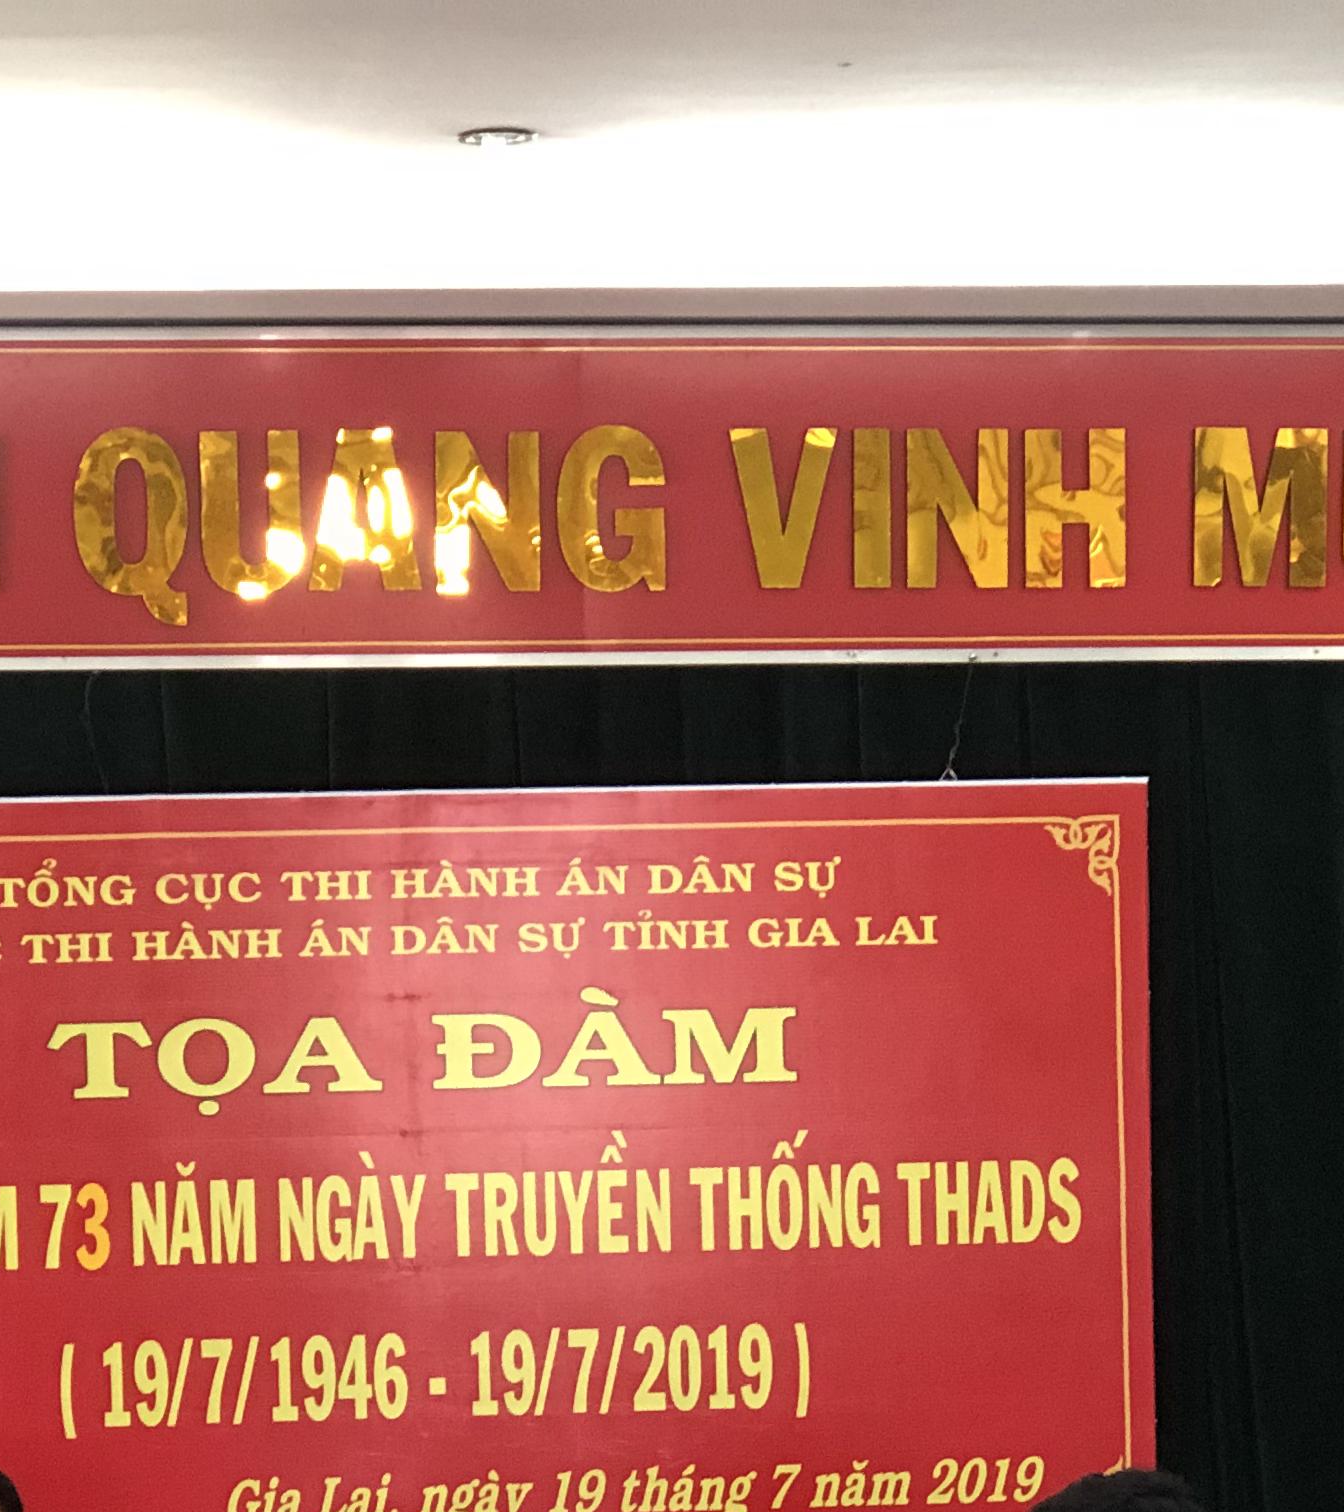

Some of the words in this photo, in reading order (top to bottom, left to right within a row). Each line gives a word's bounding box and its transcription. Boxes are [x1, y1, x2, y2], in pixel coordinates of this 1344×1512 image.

[72, 424, 666, 627] QUANG
[728, 427, 1126, 591] VINH
[155, 871, 262, 911] CỤC
[280, 870, 373, 902] THI
[390, 859, 540, 900] HÀNH
[555, 856, 629, 897] ÁN
[647, 855, 756, 895] DÂN
[774, 855, 842, 899] SỰ
[20, 932, 113, 964] THI
[131, 921, 284, 961] HÀNH
[298, 918, 372, 958] ÁN
[390, 915, 500, 956] DÂN
[517, 916, 586, 959] SỰ
[602, 910, 730, 952] TỈNH
[747, 917, 840, 949] GIA
[855, 915, 938, 946] LAI
[47, 1016, 383, 1116] TỌA
[431, 986, 798, 1090] ĐÀM
[39, 1183, 111, 1271] 73
[131, 1160, 257, 1267] NĂM
[278, 1151, 427, 1263] NGÀY
[445, 1129, 672, 1257] TRUYỀN
[689, 1128, 881, 1252] THỐNG
[896, 1157, 1082, 1246] THADS
[771, 1464, 801, 1509] 7
[810, 1457, 911, 1508] năm
[926, 1455, 1045, 1505] 2019
